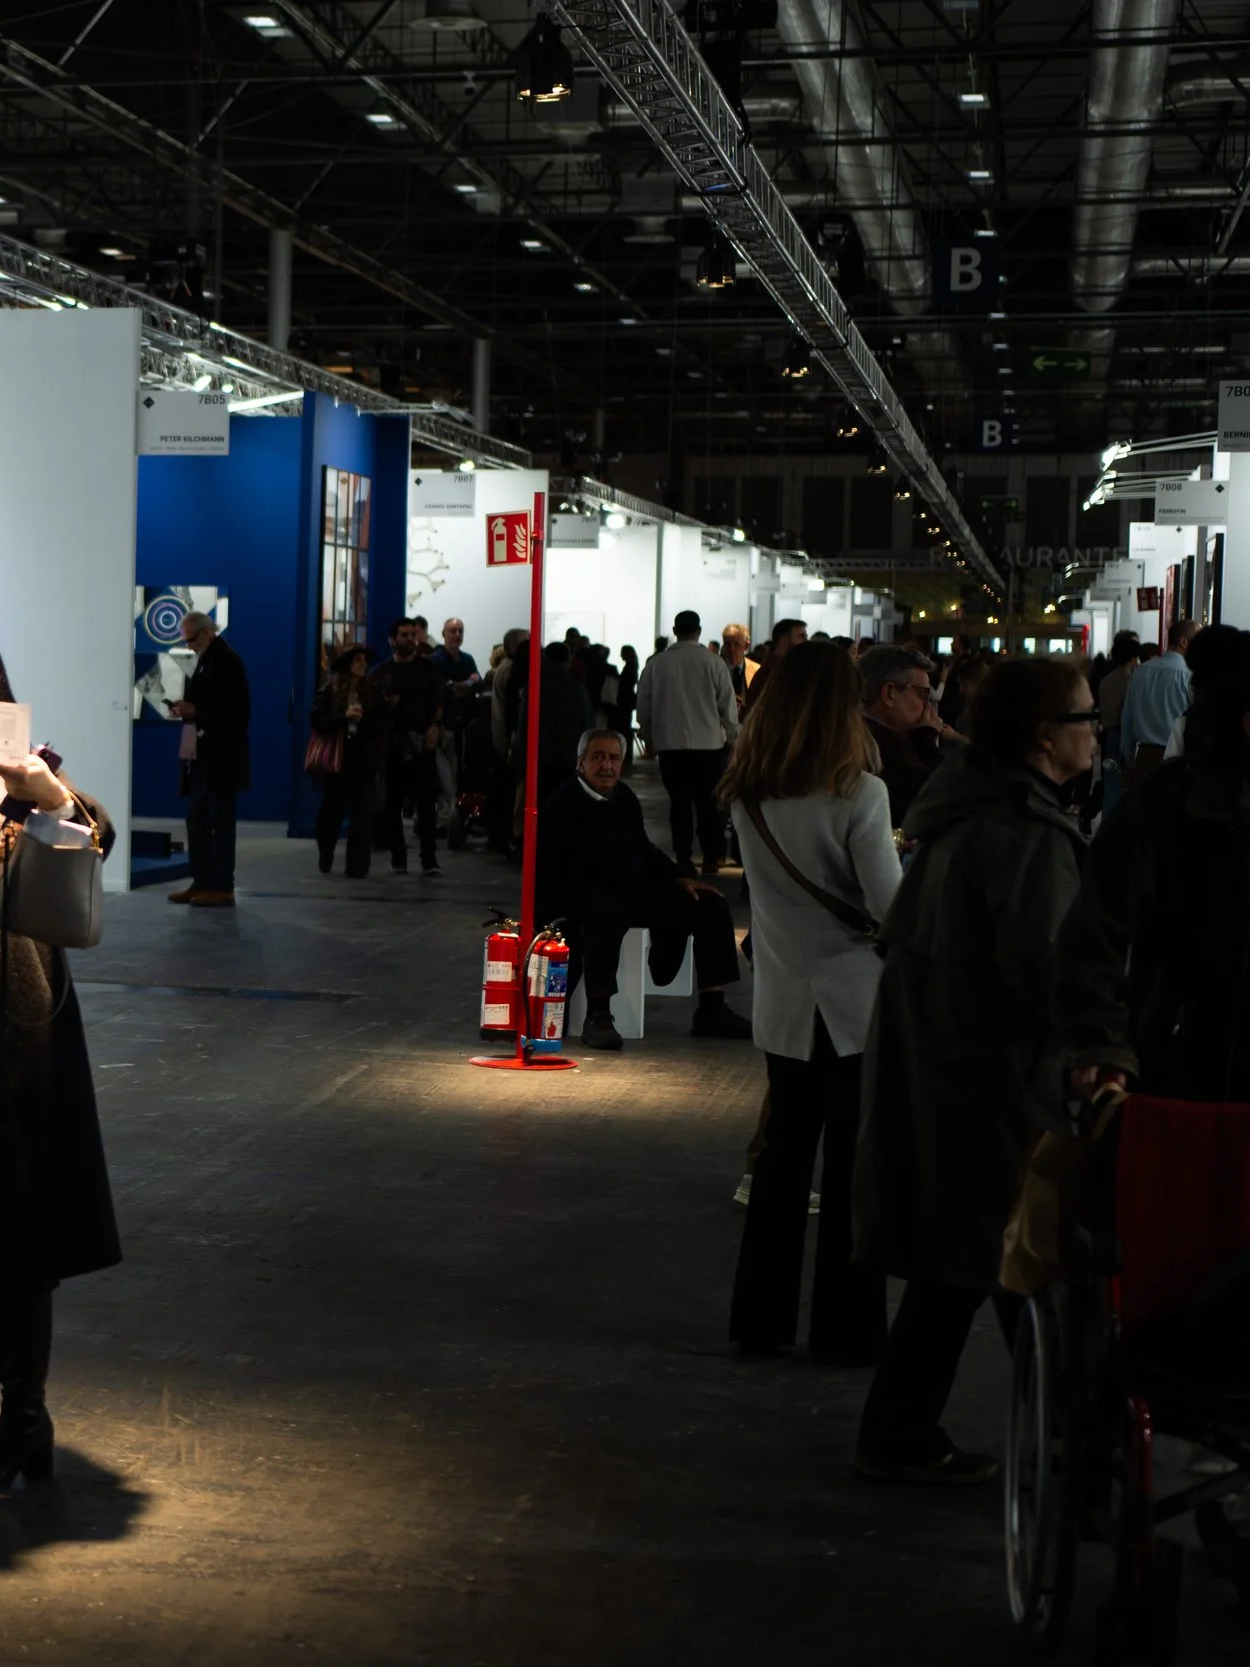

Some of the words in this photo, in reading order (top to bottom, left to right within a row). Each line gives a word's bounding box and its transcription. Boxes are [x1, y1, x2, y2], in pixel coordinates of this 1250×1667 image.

[949, 247, 983, 292] B
[197, 394, 226, 405] 7B05
[159, 435, 182, 443] PETER
[183, 435, 225, 443] KILCHMANN
[982, 420, 1003, 448] B
